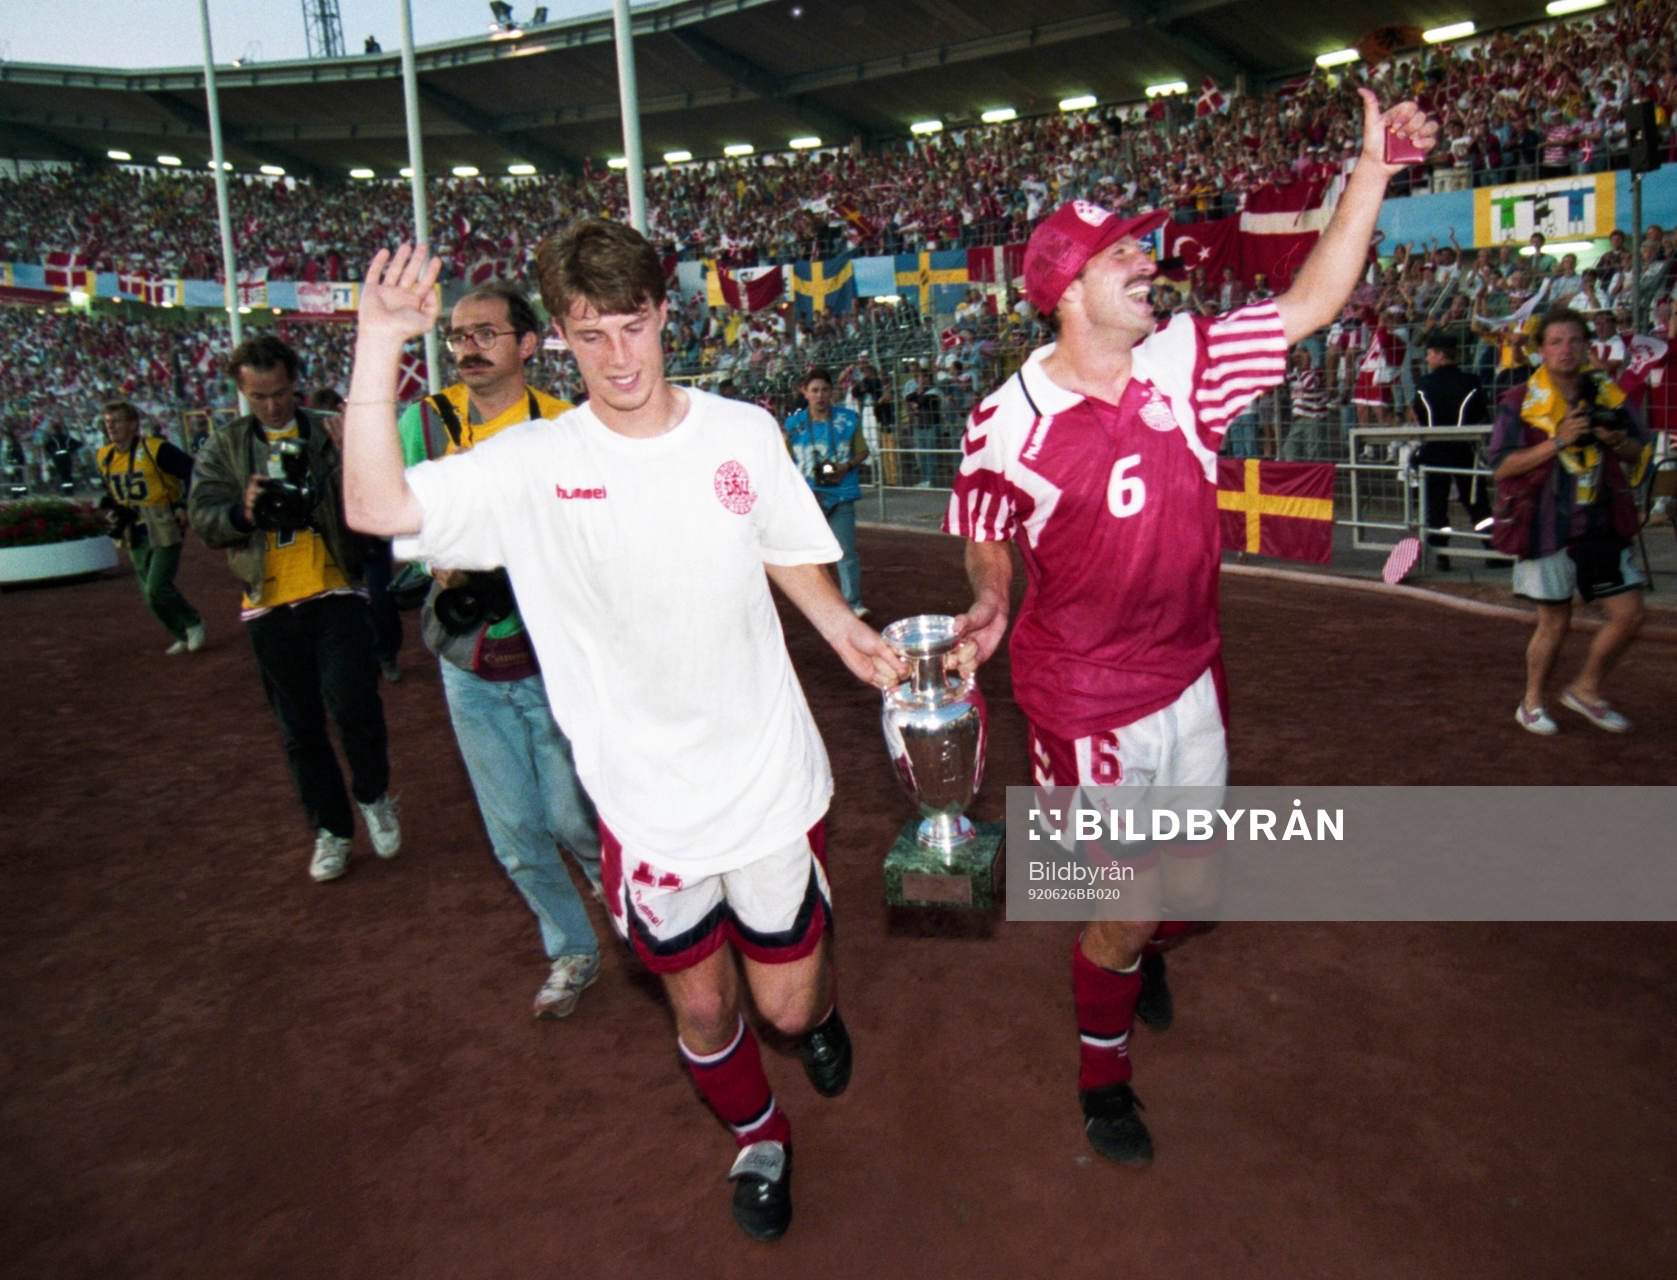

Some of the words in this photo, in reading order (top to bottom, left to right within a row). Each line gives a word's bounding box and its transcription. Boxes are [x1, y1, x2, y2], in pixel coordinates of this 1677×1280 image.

[111, 472, 147, 501] 15
[1108, 455, 1145, 518] 6
[1091, 731, 1123, 786] 6
